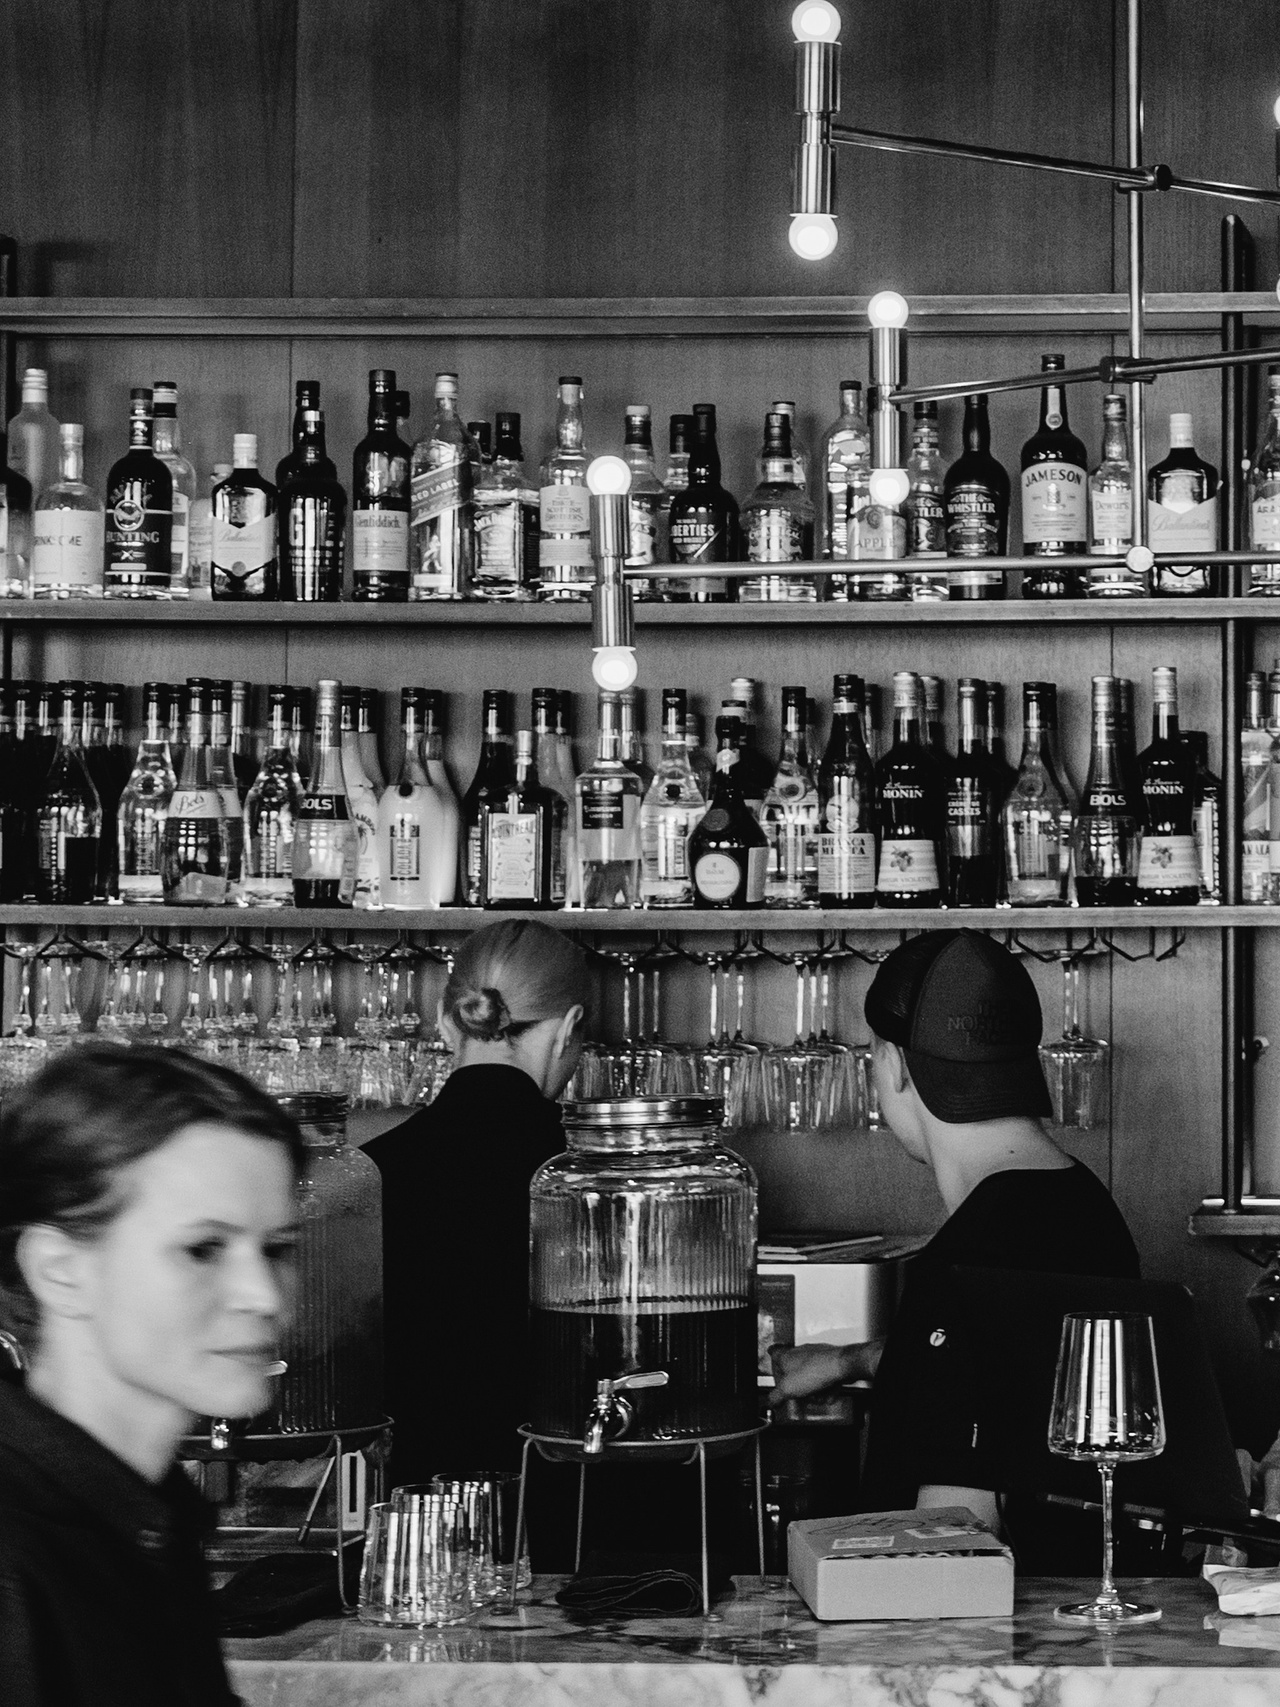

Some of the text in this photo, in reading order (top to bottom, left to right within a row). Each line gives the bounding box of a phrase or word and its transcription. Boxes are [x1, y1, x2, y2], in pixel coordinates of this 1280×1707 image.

[1025, 469, 1082, 488] JAMESON
[410, 478, 460, 502] RED LABEL
[960, 493, 979, 502] THE
[947, 503, 996, 514] WHISTLER
[883, 789, 923, 799] MONIN
[1142, 785, 1184, 795] MONIN
[1089, 794, 1127, 806] BOLS
[948, 807, 981, 816] CASSIS
